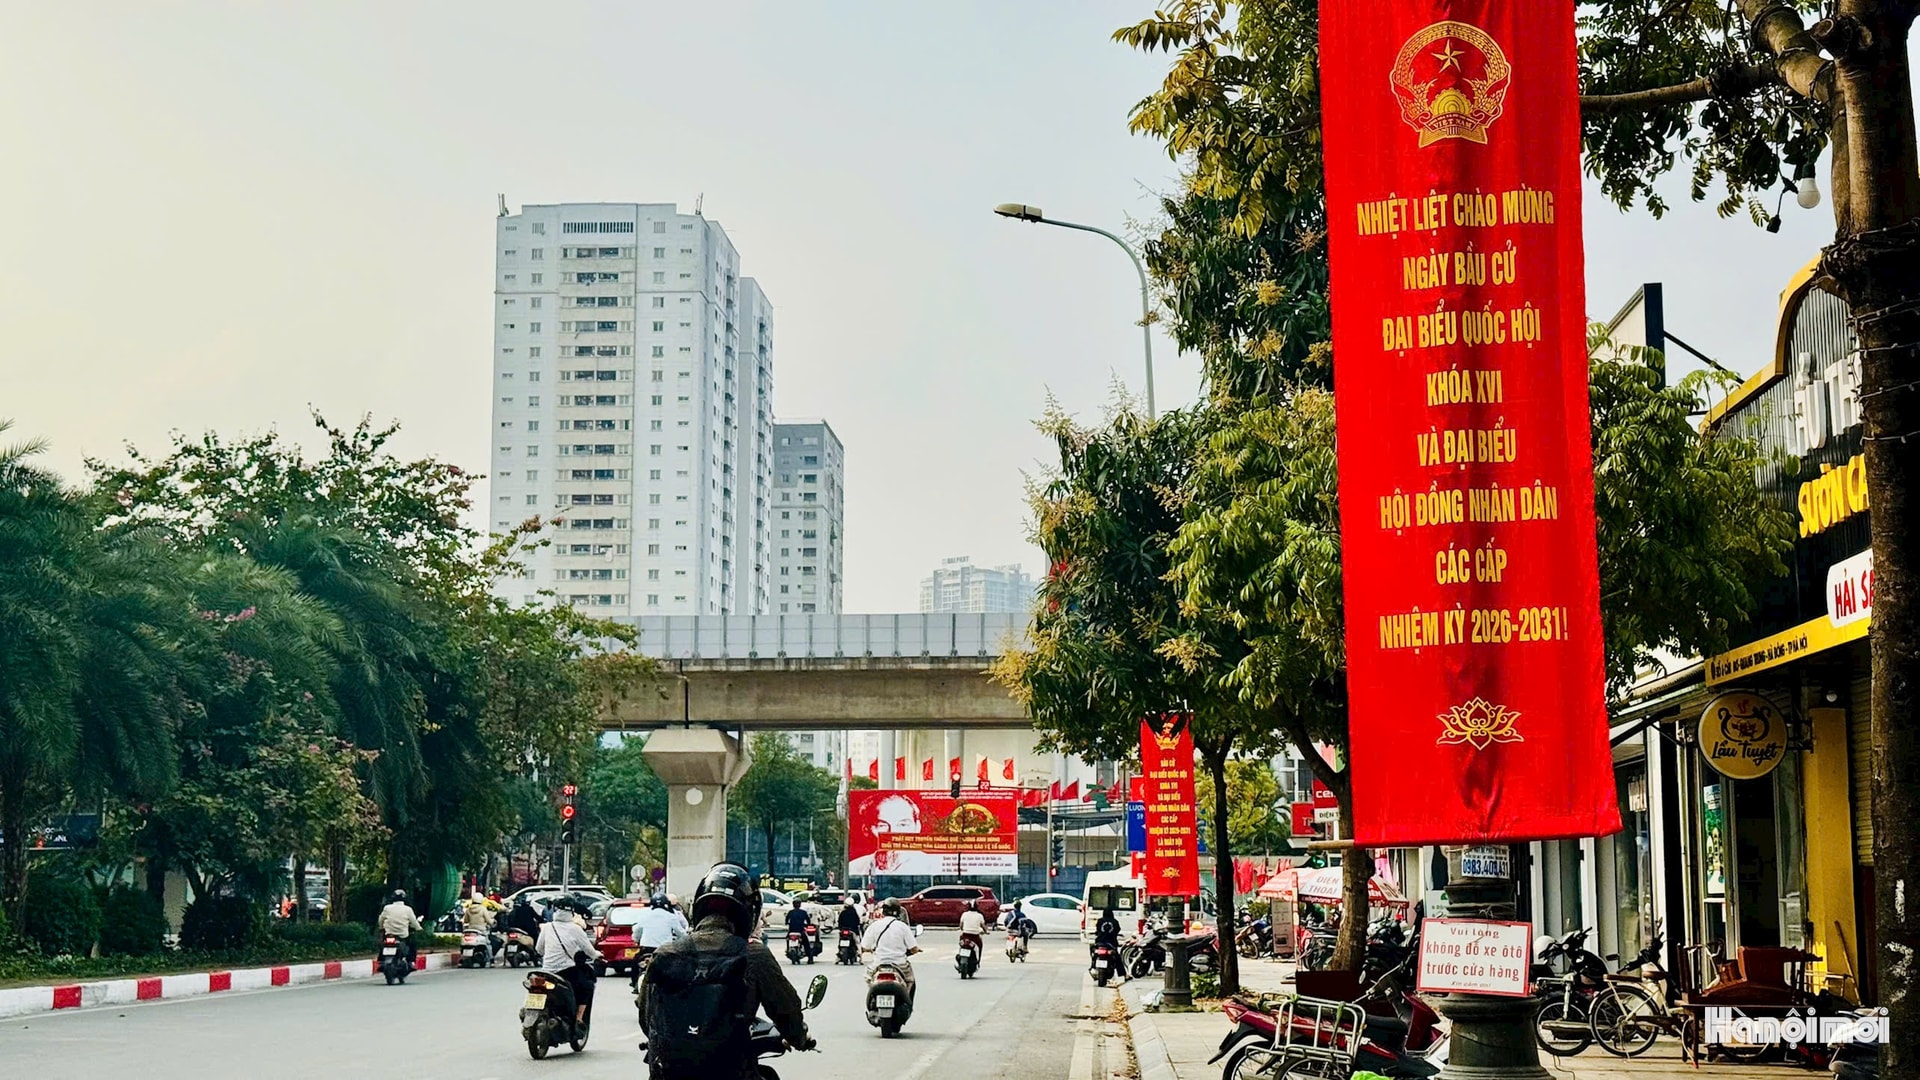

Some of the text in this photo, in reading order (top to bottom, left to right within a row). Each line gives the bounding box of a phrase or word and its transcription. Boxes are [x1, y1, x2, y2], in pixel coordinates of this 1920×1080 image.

[1357, 182, 1554, 239] NHIỆT LIỆT CHÀO MỪNG
[1403, 239, 1517, 290] NGÀY BẦU CỬ
[1382, 299, 1541, 357] ĐẠI BIỂU QUỐC HỘI
[1426, 363, 1503, 407] KHÓA XVI
[1417, 416, 1517, 471] VÀ ĐẠI BIỂU
[1380, 479, 1558, 536] HỘI ĐỒNG NHÂN DÂN
[1799, 463, 1847, 538] SƯỜN
[1435, 536, 1508, 585] CÁC CẤP
[1834, 568, 1856, 619] HẢI
[1379, 602, 1568, 655] NHIỆM KỲ 2026-2031!
[1712, 740, 1783, 766] Lẩu Tuyết
[1426, 942, 1461, 957] không
[1484, 947, 1497, 957] xe
[1502, 944, 1523, 958] ôtô
[1450, 927, 1499, 939] Vui lòng
[1427, 962, 1519, 981] trước cửa hàng
